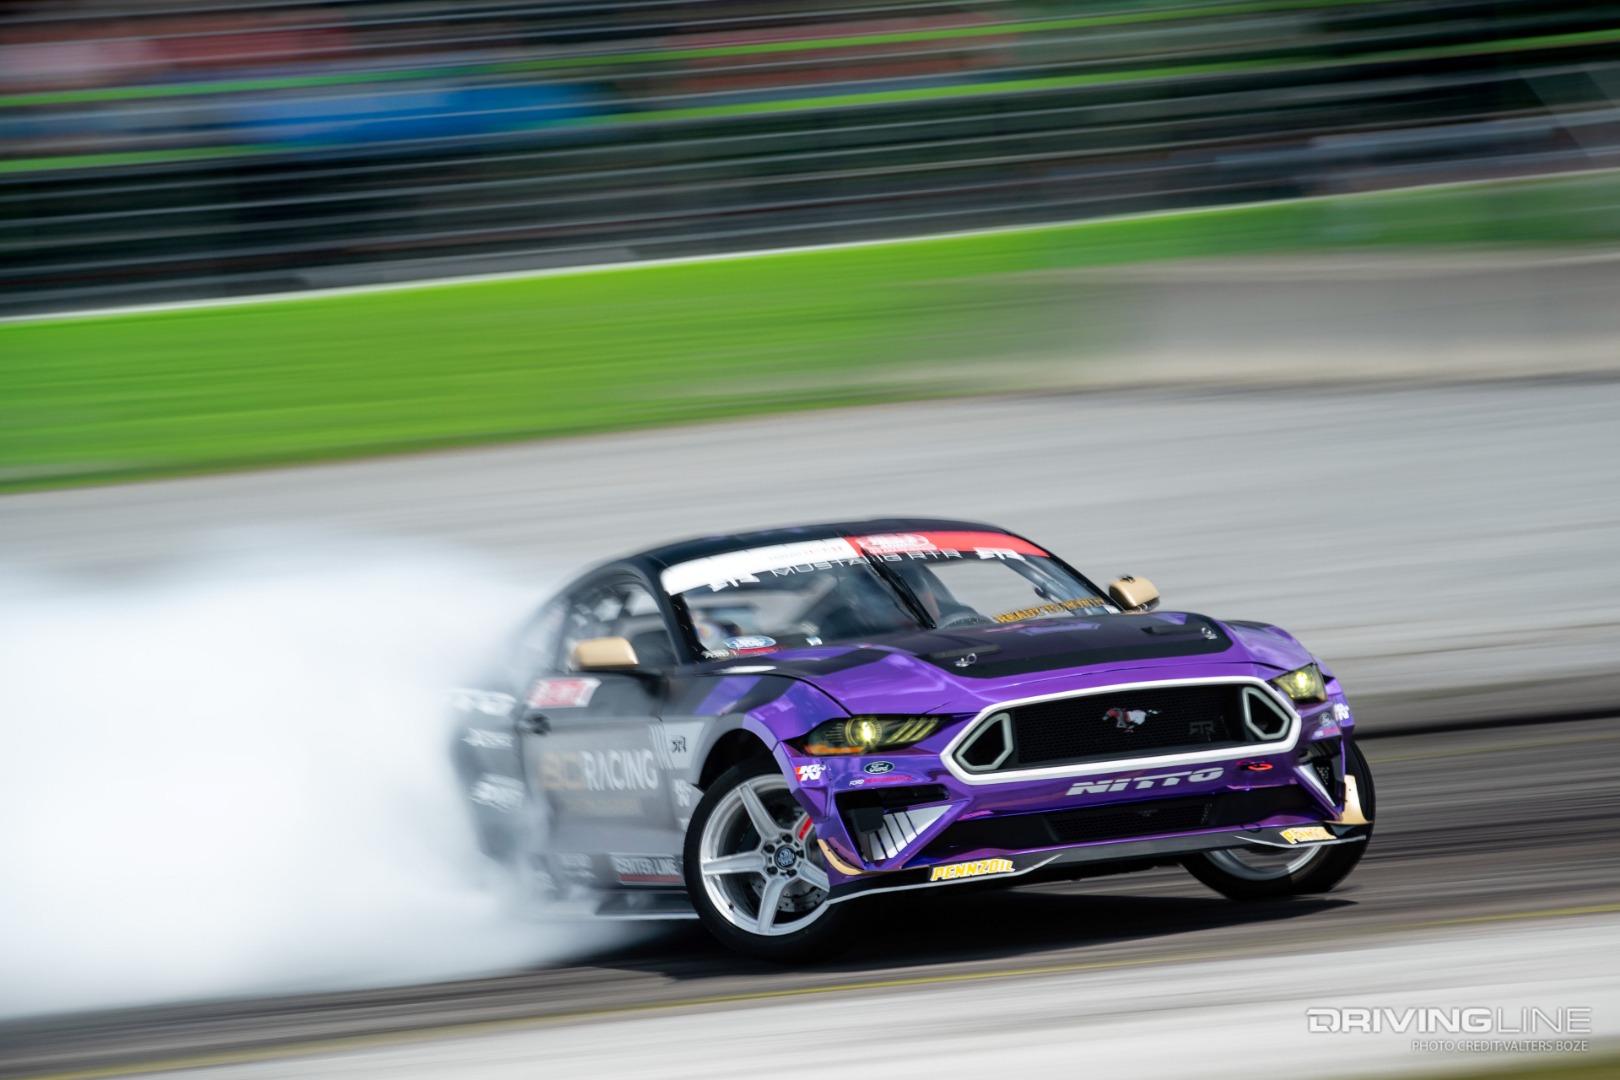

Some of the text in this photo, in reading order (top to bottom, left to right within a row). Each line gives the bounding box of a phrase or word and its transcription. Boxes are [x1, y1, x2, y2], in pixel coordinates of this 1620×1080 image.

[582, 749, 659, 792] RACING
[794, 764, 827, 781] K&N
[867, 762, 891, 773] Ford
[1065, 767, 1225, 796] NITTO
[930, 858, 1016, 881] PENNZOIL
